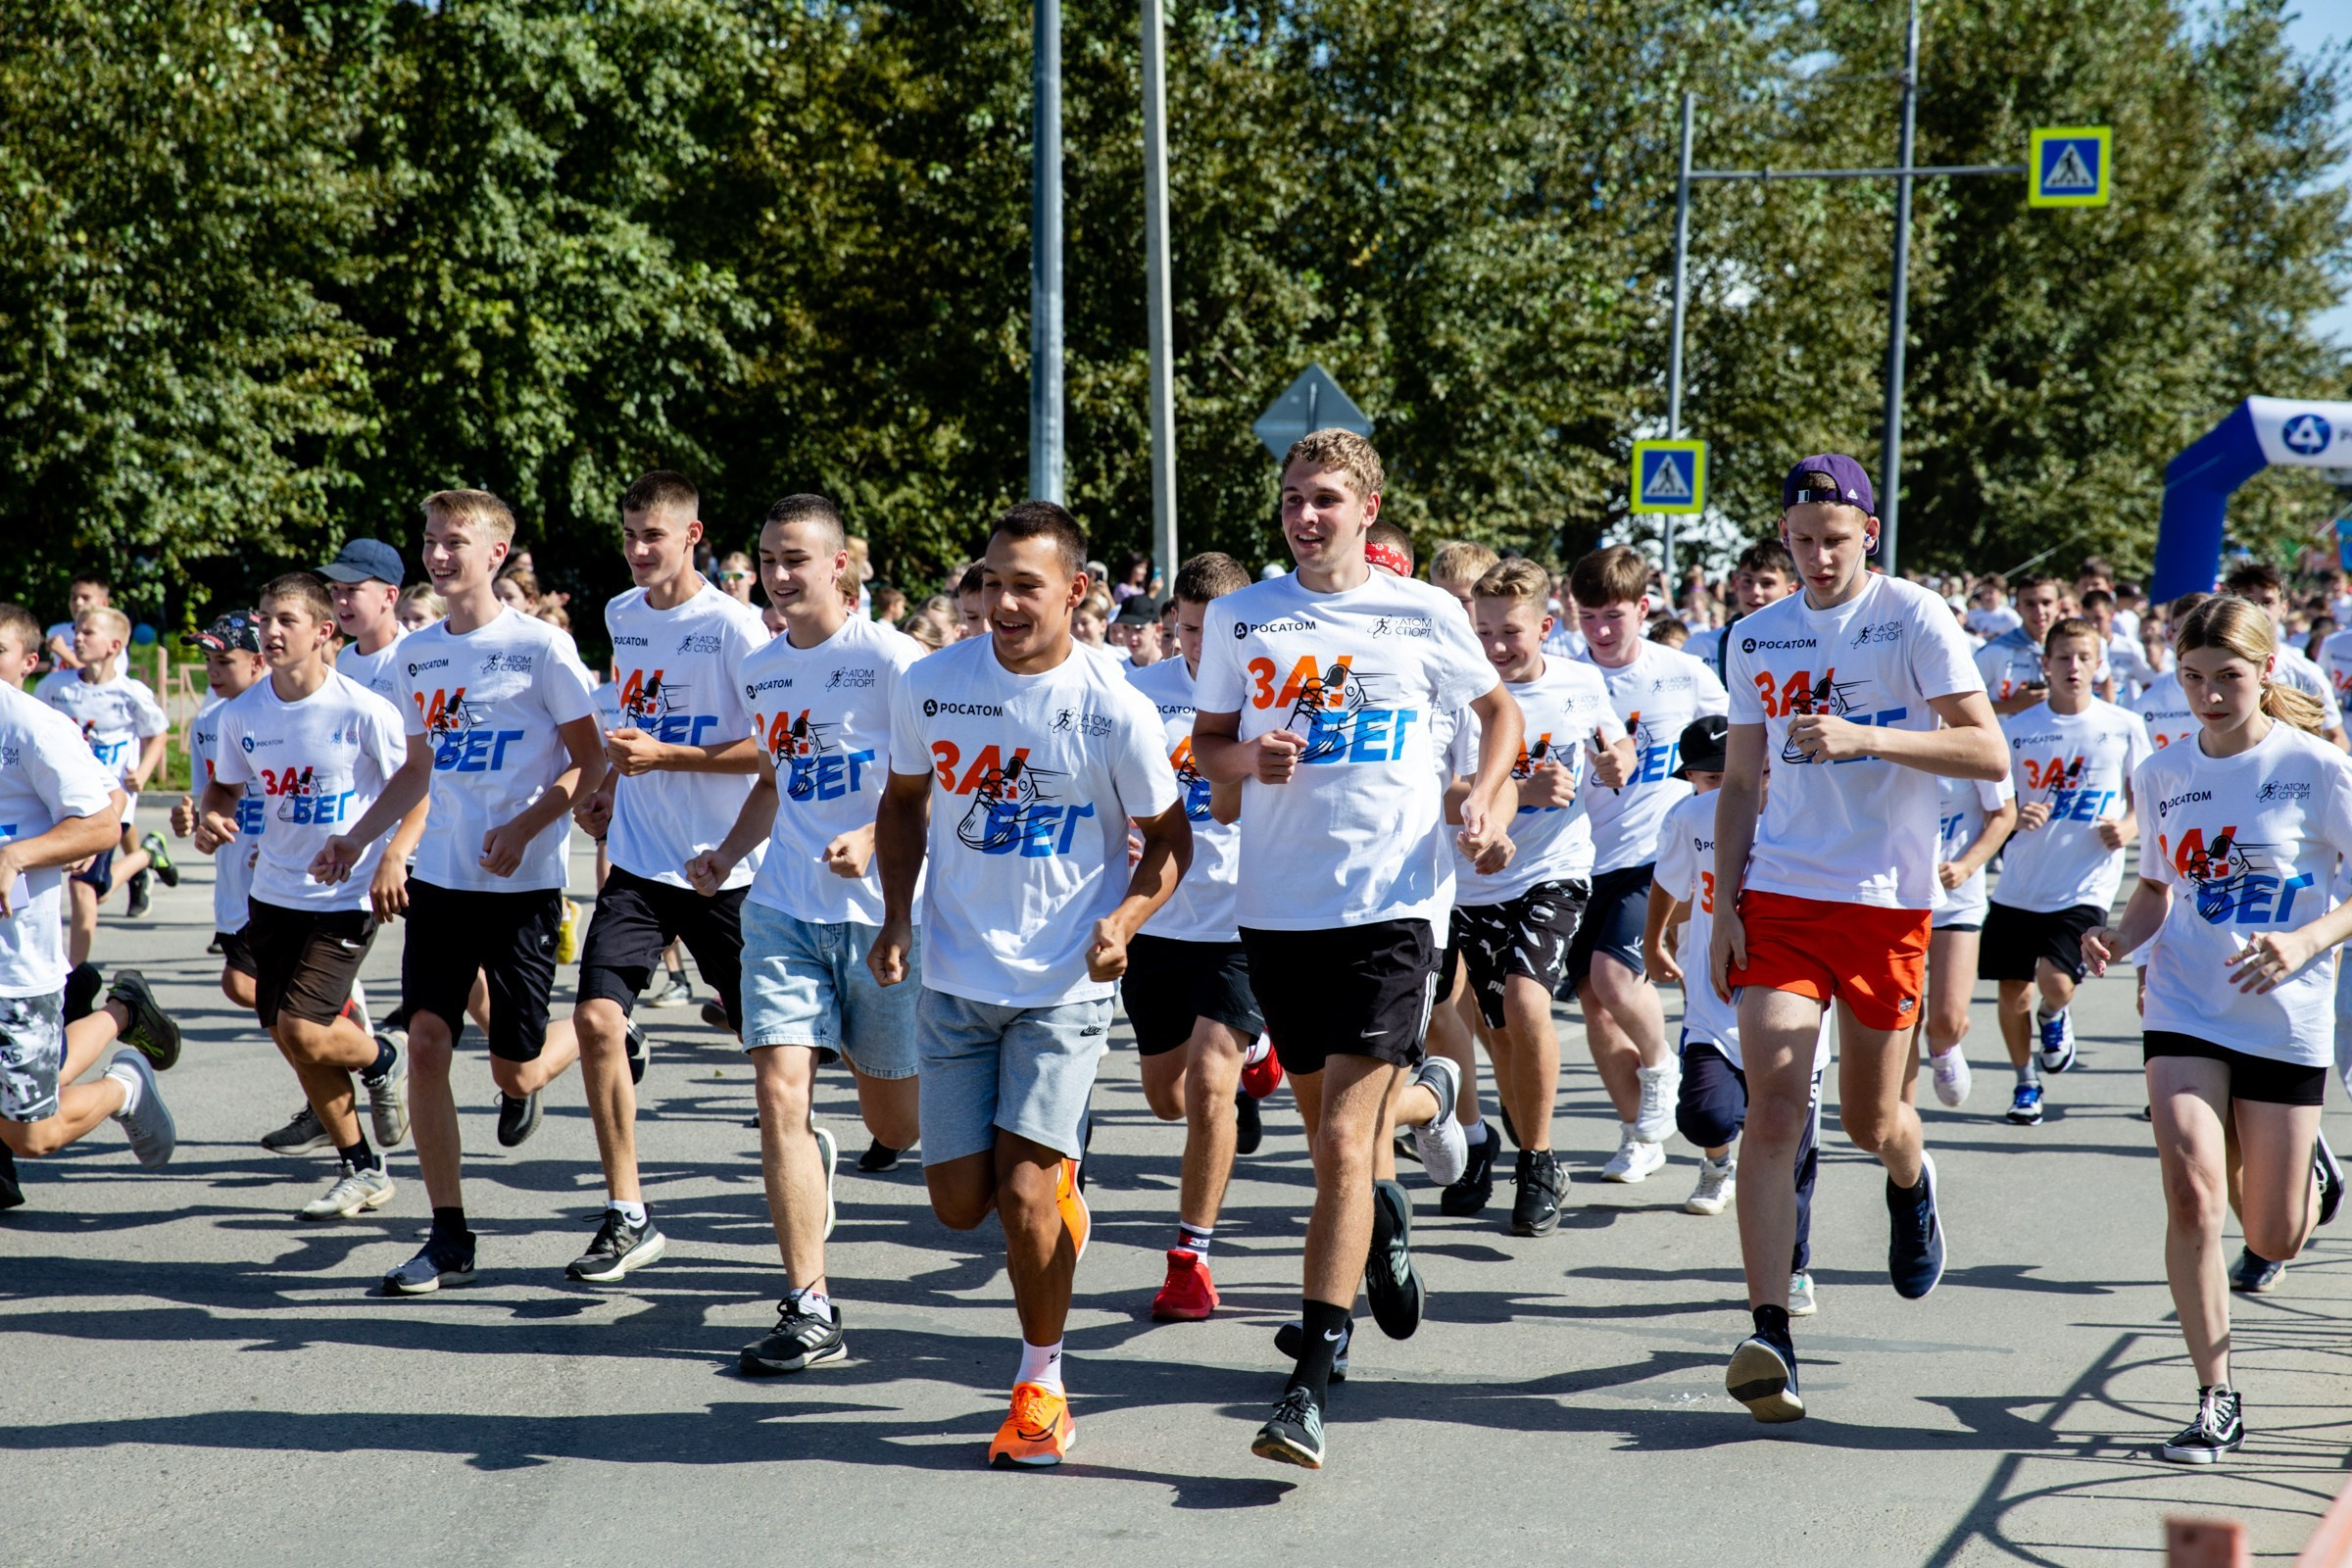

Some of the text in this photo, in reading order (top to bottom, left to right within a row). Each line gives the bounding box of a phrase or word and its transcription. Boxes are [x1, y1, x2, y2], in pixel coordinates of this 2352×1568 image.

[1250, 621, 1317, 634] РОСАТОМ
[1399, 617, 1433, 628] АТОМ
[1877, 620, 1903, 633] АТОМ
[1396, 626, 1433, 638] СПОРТ
[1758, 639, 1817, 650] РОСАТОМ
[417, 659, 450, 672] РОСАТОМ
[506, 655, 532, 663] АТОМ
[500, 663, 532, 672] СПОРТ
[848, 668, 875, 678] АТОМ
[754, 678, 793, 694] РОСАТОМ
[843, 678, 876, 688] СПОРТ
[1247, 656, 1353, 710] ЗА!
[940, 703, 1004, 717] РОСАТОМ
[1081, 713, 1112, 728] АТОМ
[1075, 723, 1111, 739] СПОРТ
[1302, 709, 1418, 764] БЕГ
[256, 738, 284, 748] РОСАТОМ
[433, 729, 525, 771] БЕГ
[787, 749, 876, 802] БЕГ
[930, 739, 1031, 800] ЗА!
[2023, 756, 2085, 790] ЗА!
[261, 765, 314, 796] ЗА!
[2282, 782, 2311, 792] АТОМ
[2168, 790, 2212, 809] РОСАТОМ
[2278, 791, 2311, 801] СПОРТ
[294, 789, 356, 824] БЕГ
[2049, 790, 2117, 822] БЕГ
[981, 802, 1095, 858] БЕГ
[2195, 872, 2315, 925] БЕГ
[1487, 980, 1506, 997] PU
